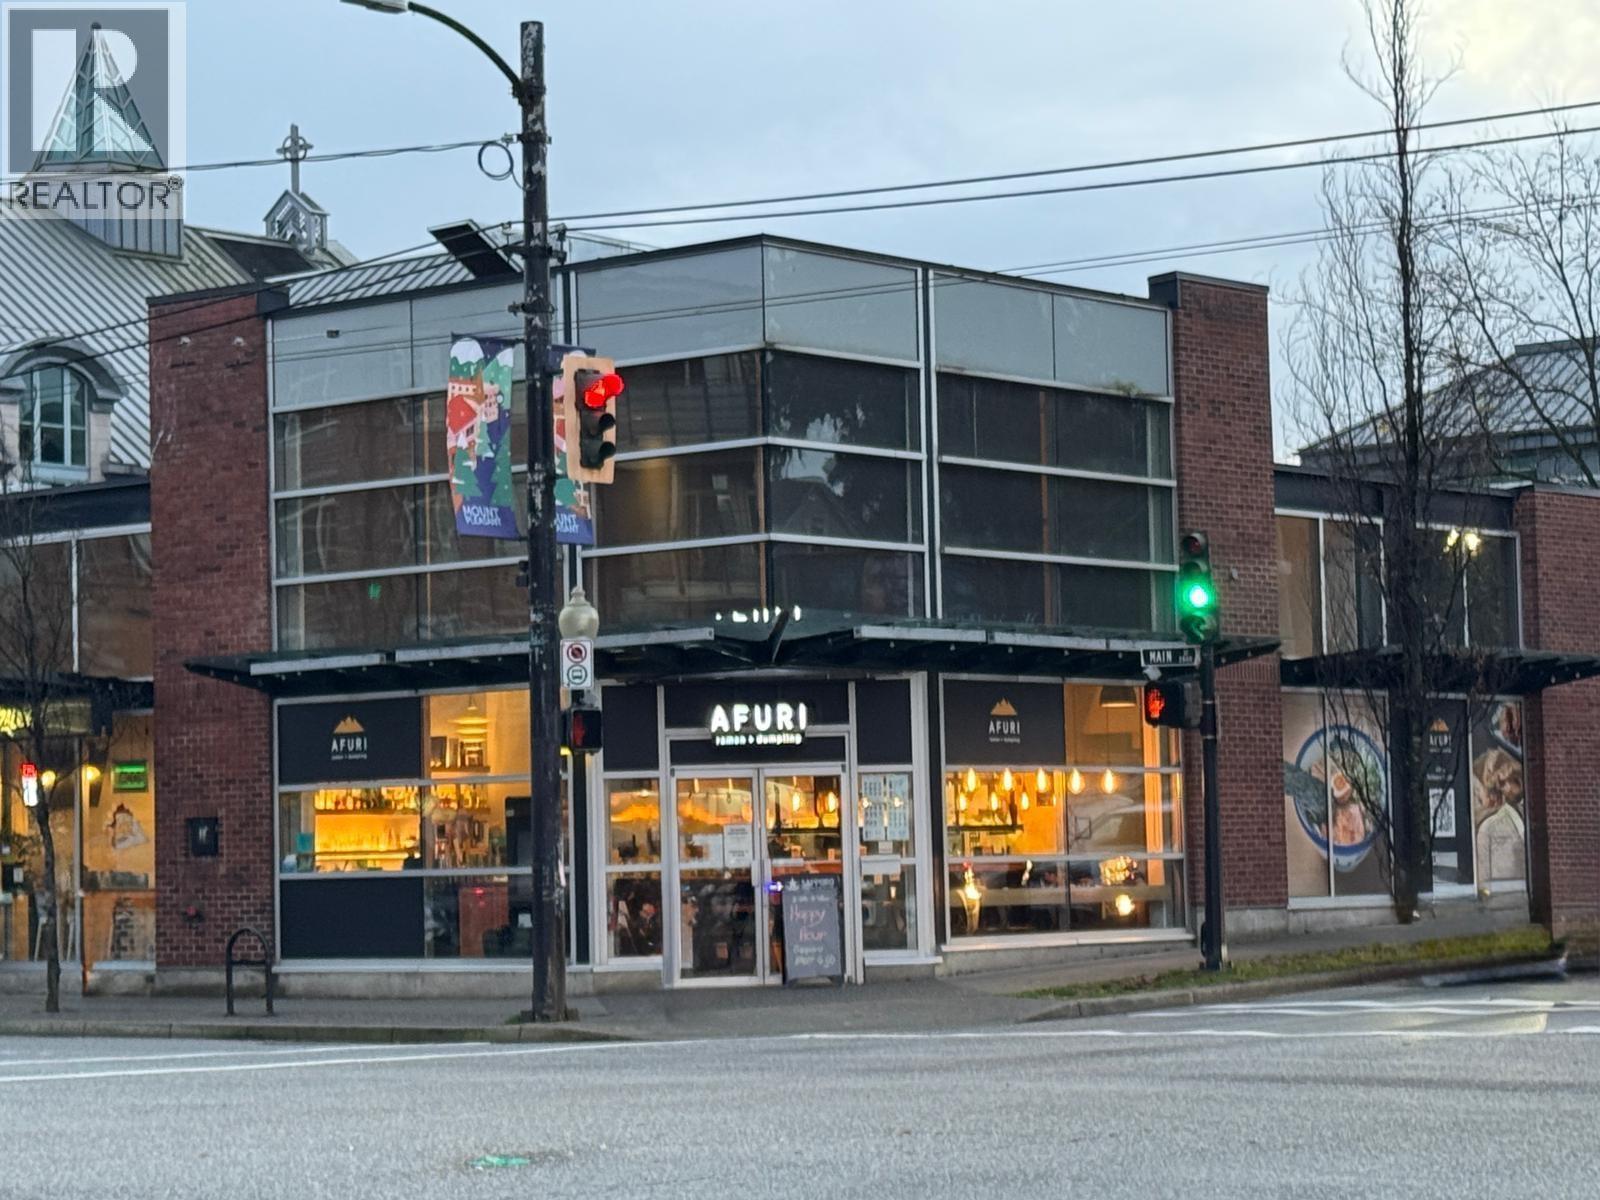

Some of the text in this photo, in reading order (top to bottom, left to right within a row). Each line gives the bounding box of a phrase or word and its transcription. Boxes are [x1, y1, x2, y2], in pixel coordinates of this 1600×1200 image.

[462, 503, 499, 517] MOUNT
[1149, 650, 1173, 664] MAIN
[710, 702, 808, 732] AFURI
[989, 719, 1020, 735] AFURI
[331, 737, 367, 752] AFURI
[756, 733, 803, 745] dumpling
[789, 904, 826, 927] Happy
